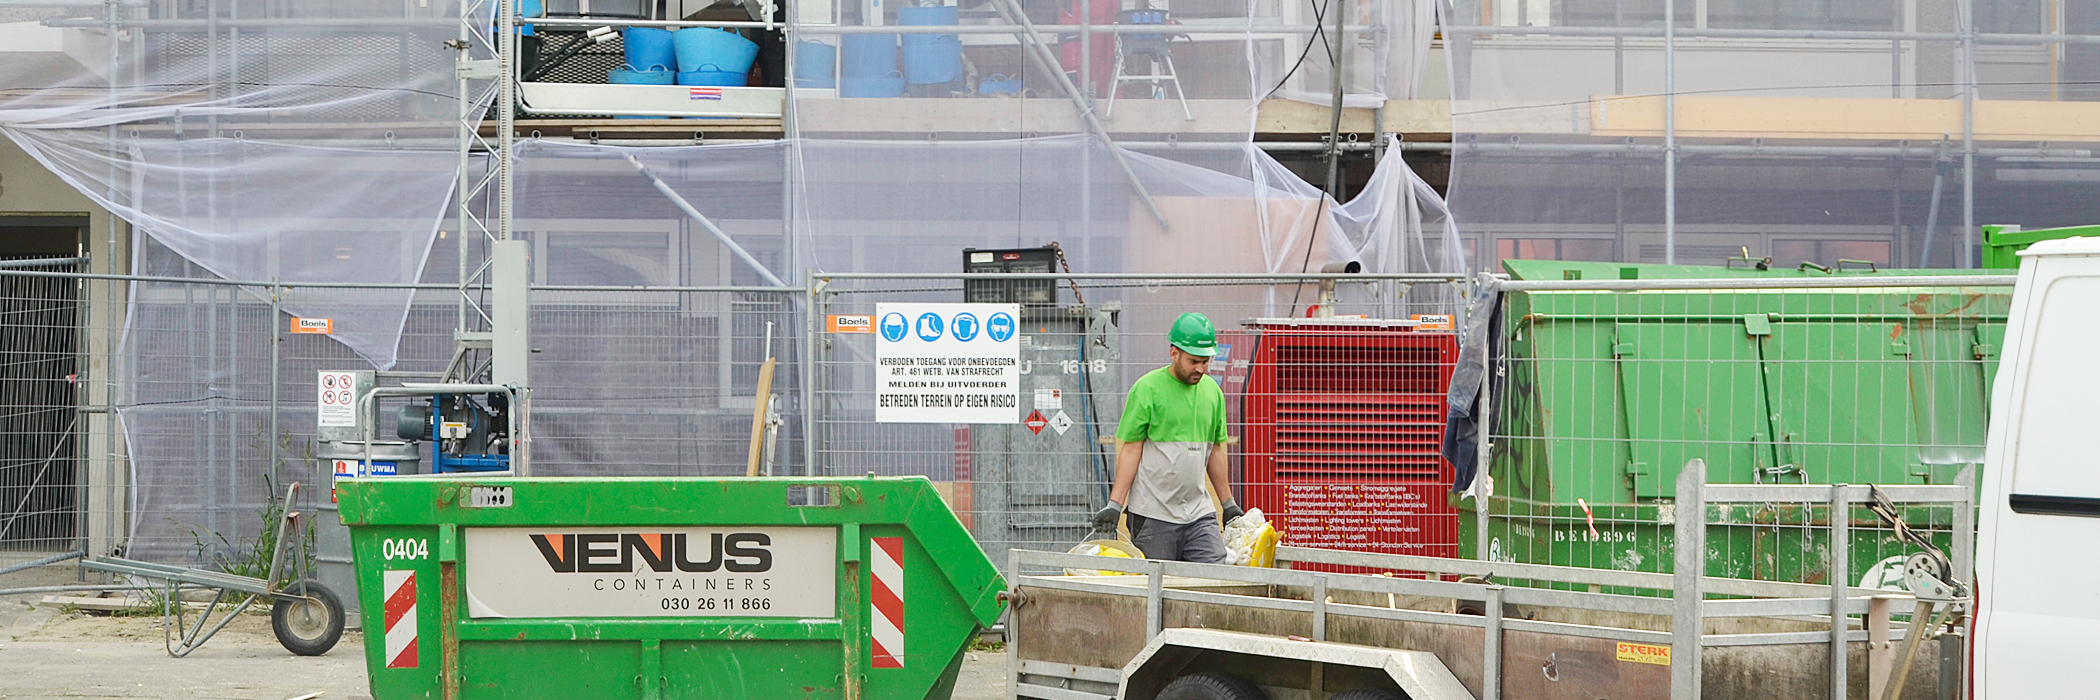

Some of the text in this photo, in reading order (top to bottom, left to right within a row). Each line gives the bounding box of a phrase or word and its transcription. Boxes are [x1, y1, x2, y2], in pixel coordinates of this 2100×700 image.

[839, 317, 868, 325] Boels
[880, 357, 1016, 366] VERBODEN TOEGANG VOOR ONBEVOEGDEN
[892, 367, 907, 376] ART.
[923, 367, 943, 376] WETB.
[946, 367, 960, 376] VAN
[961, 367, 1004, 376] STRAFRECHT
[880, 394, 1016, 408] BETREDEN TERREIN OP EIGEN RISICO
[359, 465, 396, 473] BUWMA
[383, 538, 429, 560] 0404
[529, 533, 773, 573] VENUS
[594, 578, 771, 590] CONTAINERS
[661, 598, 771, 610] 030 26 11 866
[1619, 644, 1669, 657] STERK
